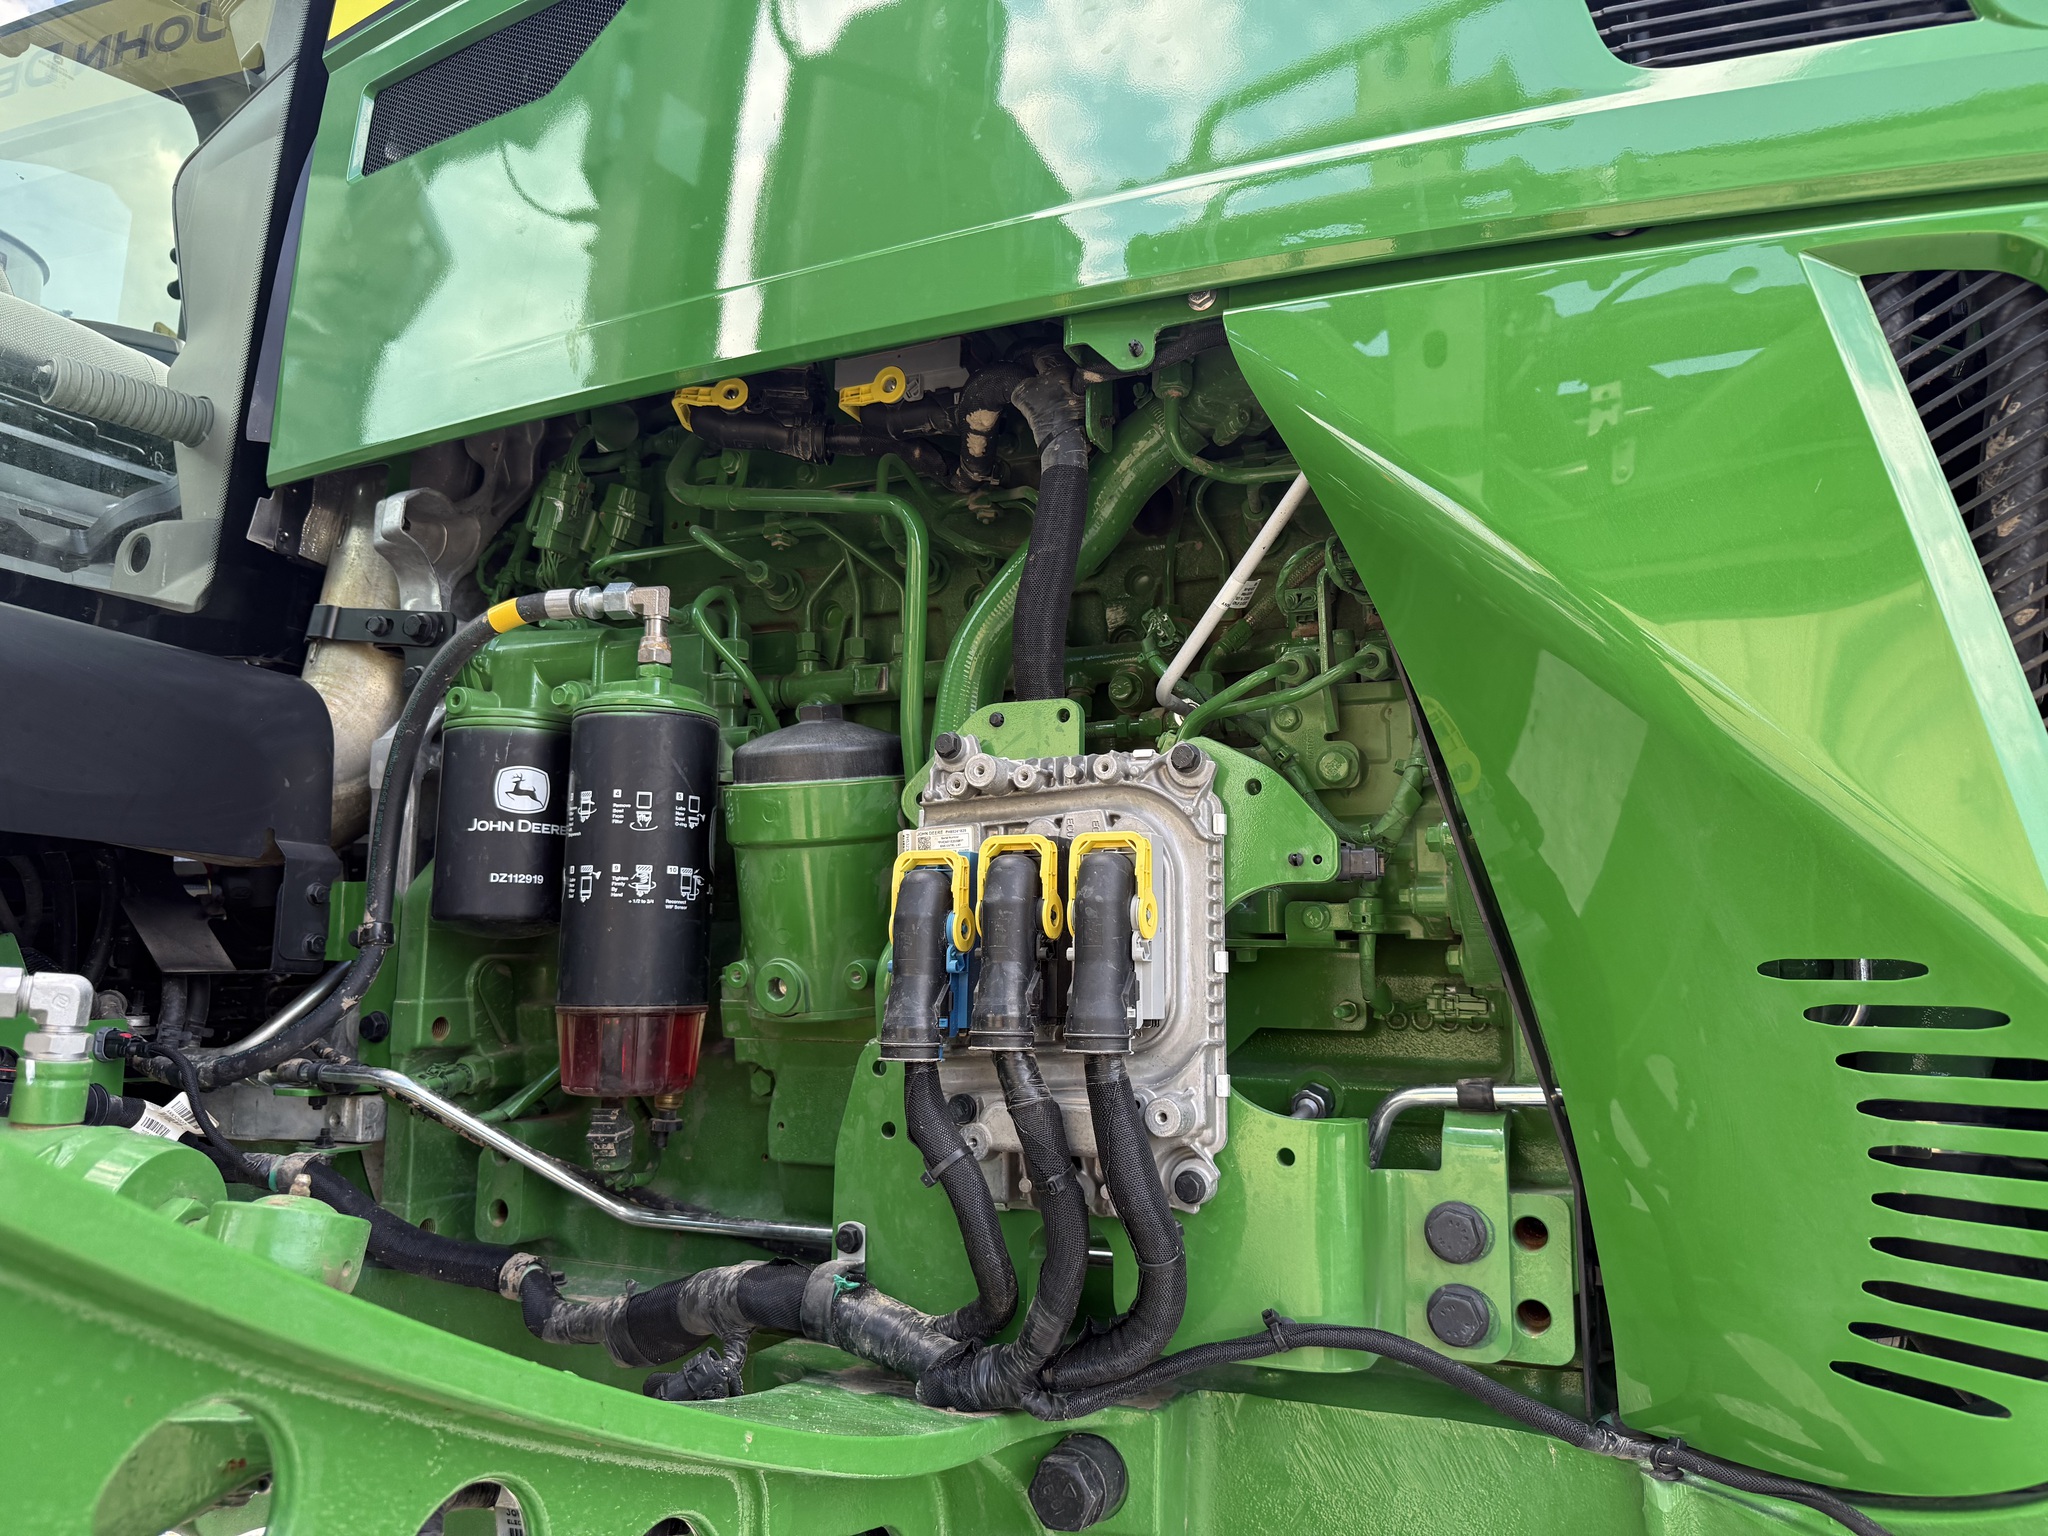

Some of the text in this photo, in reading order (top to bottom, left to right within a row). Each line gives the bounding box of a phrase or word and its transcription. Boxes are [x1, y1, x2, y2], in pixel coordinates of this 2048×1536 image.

[467, 818, 514, 832] JOHN
[518, 819, 568, 836] DEERE
[489, 872, 544, 885] DZ112919
